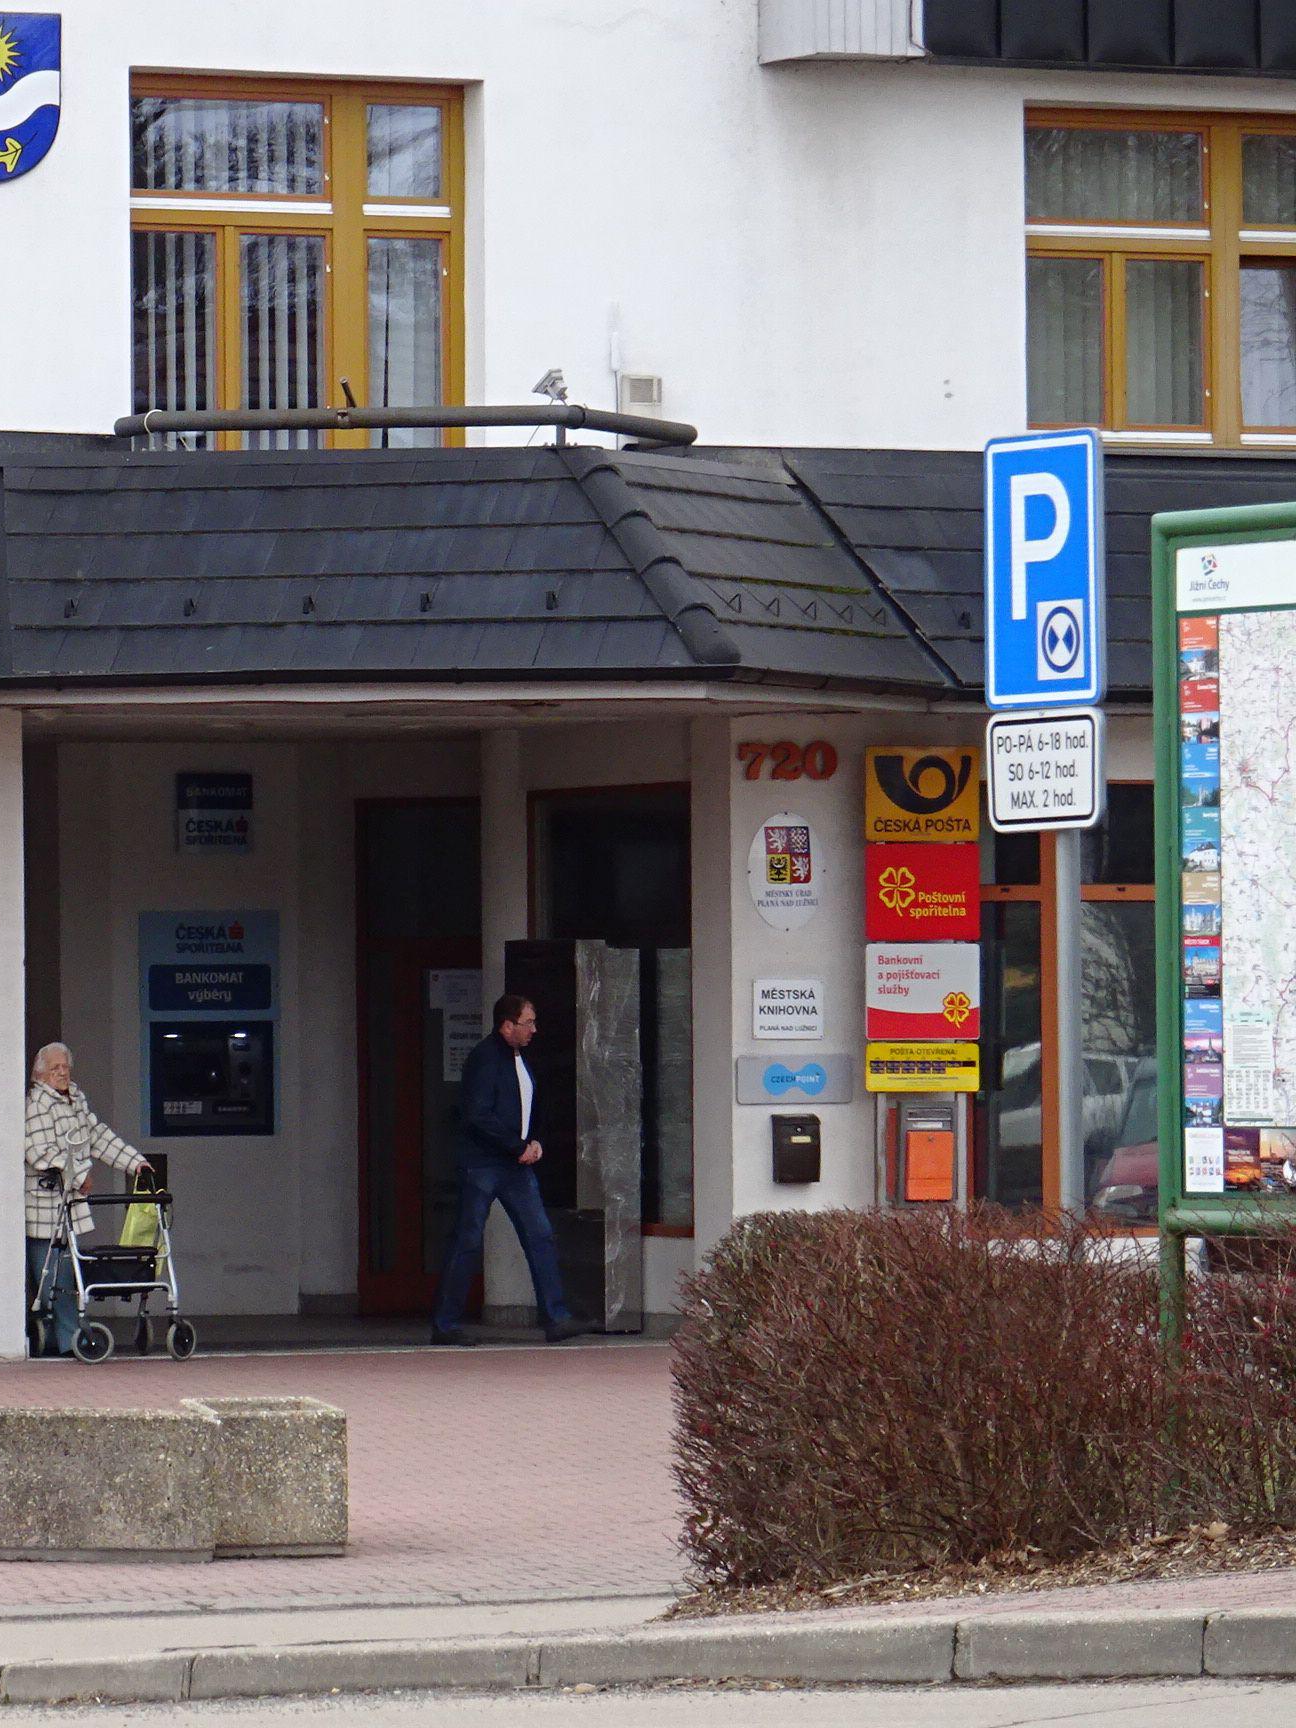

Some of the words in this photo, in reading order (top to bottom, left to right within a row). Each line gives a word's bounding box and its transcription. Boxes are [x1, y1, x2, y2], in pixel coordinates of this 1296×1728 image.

[1010, 472, 1071, 620] P
[996, 729, 1035, 755] PO-PÁ
[1038, 731, 1061, 752] 6-18
[1064, 729, 1090, 751] hod.
[737, 740, 838, 781] 720
[1008, 763, 1025, 782] SO
[1028, 762, 1052, 782] 6-12
[1055, 759, 1079, 779] hod.
[1010, 790, 1039, 810] MAX.
[1042, 789, 1050, 808] 2
[1053, 787, 1077, 808] hod.
[185, 817, 235, 833] ČESKÁ
[873, 815, 921, 833] ČESKÁ
[924, 818, 973, 833] POŠTA
[918, 891, 966, 904] Poštovní
[909, 904, 967, 920] spořitelna
[175, 921, 227, 940] ČESKÁ
[877, 954, 923, 966] Bankovní
[175, 971, 244, 984] BANKOMAT
[877, 971, 884, 980] a
[885, 968, 941, 984] pojišťovací
[187, 987, 233, 1003] výběry
[761, 987, 816, 1000] MĚSTSKÁ
[877, 983, 910, 998] služby
[759, 1005, 818, 1016] KNIHOVNA
[889, 1047, 915, 1056] POŠTA
